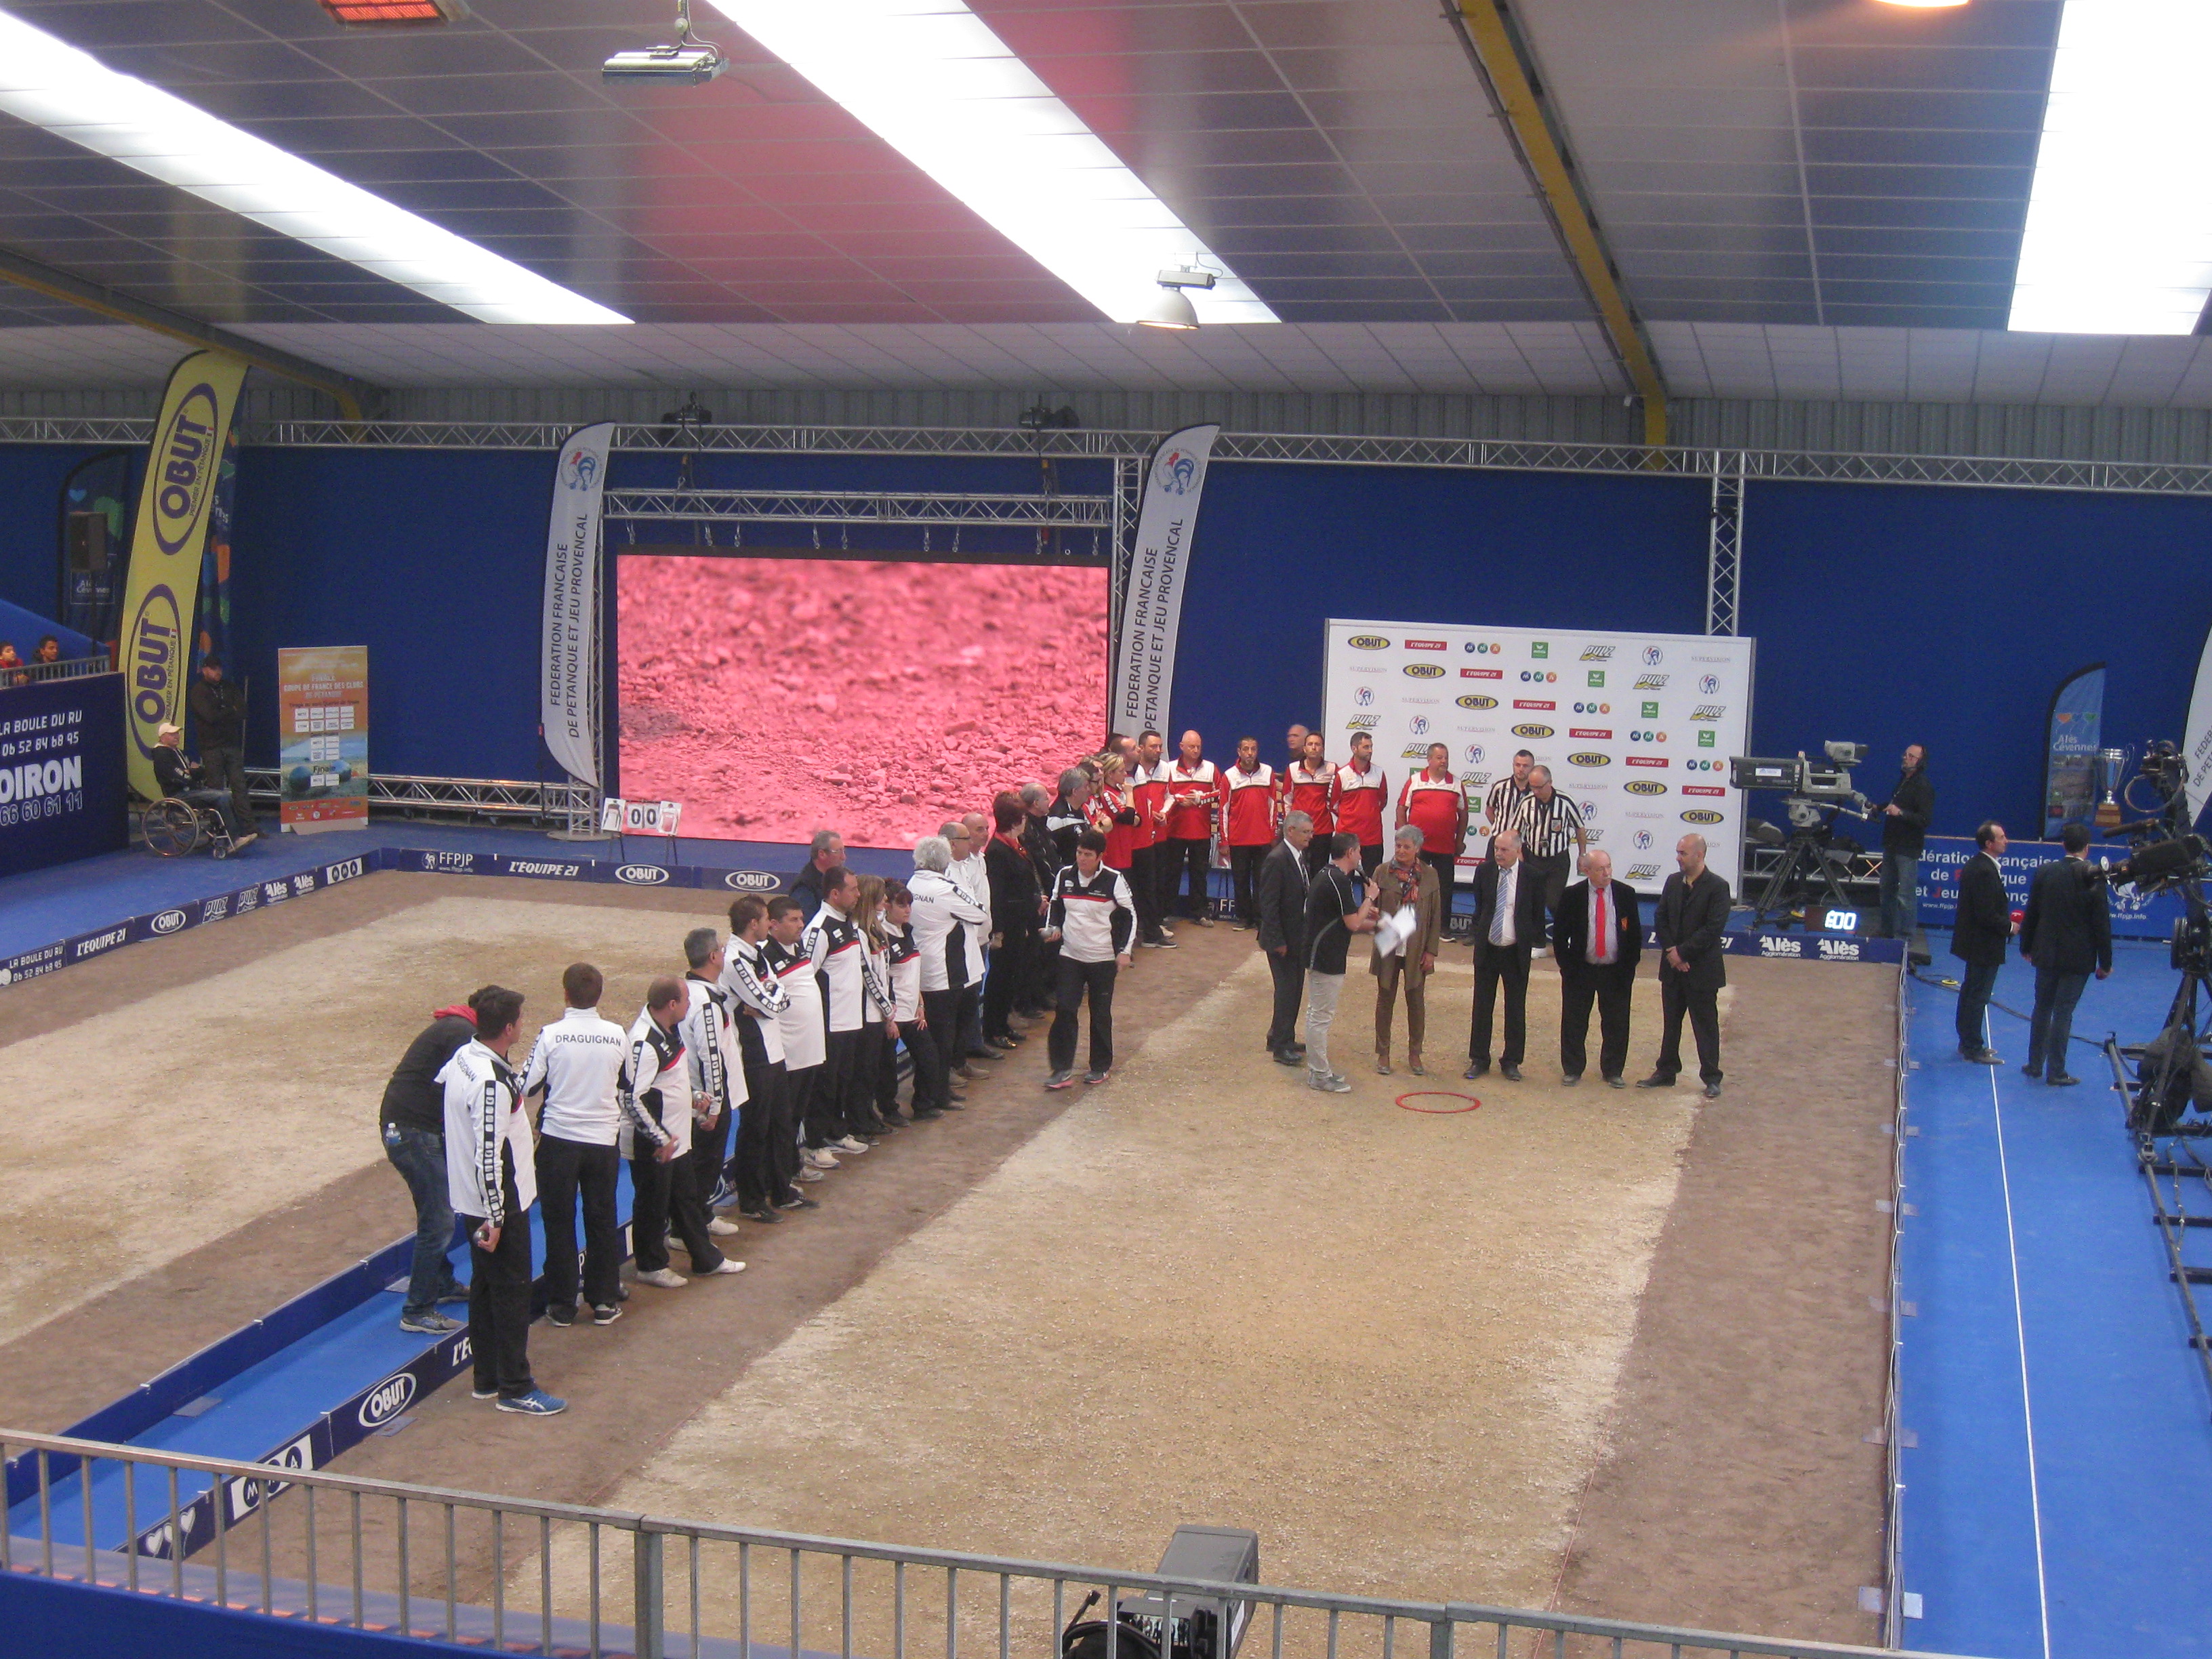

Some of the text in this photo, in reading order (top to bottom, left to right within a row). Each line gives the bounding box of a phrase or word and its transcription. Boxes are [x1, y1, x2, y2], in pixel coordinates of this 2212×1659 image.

[160, 414, 207, 519] OBUT
[550, 544, 568, 706] FEDERATION FRANCAISE
[567, 514, 588, 738] DE PETANQUE ET JEU PROVENCAL
[1144, 518, 1183, 731] PETANQUE ET JEU PROVENCAL
[1126, 548, 1158, 718] FEDERATION FRANCAISE
[1356, 637, 1381, 648] OBUT
[136, 617, 171, 724] OBUT
[1411, 666, 1437, 676] OBUT
[1464, 697, 1490, 708] OBUT
[14, 716, 47, 733] BOULE
[51, 713, 65, 727] DU
[68, 710, 83, 724] RU
[1519, 726, 1546, 736] OBUT
[18, 739, 32, 754] 52
[35, 737, 48, 751] 84
[67, 731, 79, 745] 95
[1406, 743, 1431, 754] PUL
[2194, 725, 2212, 760] FEDER
[1576, 754, 1603, 764] OBUT
[2193, 771, 2204, 787] DE
[1633, 783, 1658, 793] OBUT
[22, 800, 41, 821] 60
[44, 795, 61, 817] 61
[66, 790, 83, 812] 11
[1689, 811, 1715, 821] OBUT
[440, 852, 473, 867] FFPJP
[1918, 849, 1973, 864] dératio
[564, 865, 579, 876] 21
[626, 867, 657, 880] OBUT
[1931, 868, 1949, 880] de
[293, 874, 314, 889] Alès
[736, 874, 769, 887] OBUT
[264, 882, 287, 897] Alès
[1915, 885, 1928, 897] et
[158, 912, 180, 929] OBUT
[116, 928, 127, 943] 21
[1759, 935, 1801, 953] Alès
[1817, 938, 1860, 956] Alès
[9, 958, 19, 969] LA
[20, 951, 43, 966] BOULE
[44, 947, 53, 959] DU
[24, 968, 33, 979] 52
[35, 965, 43, 976] 84
[555, 1034, 621, 1047] DRAGUIGNAN
[371, 1376, 405, 1418] OBUT
